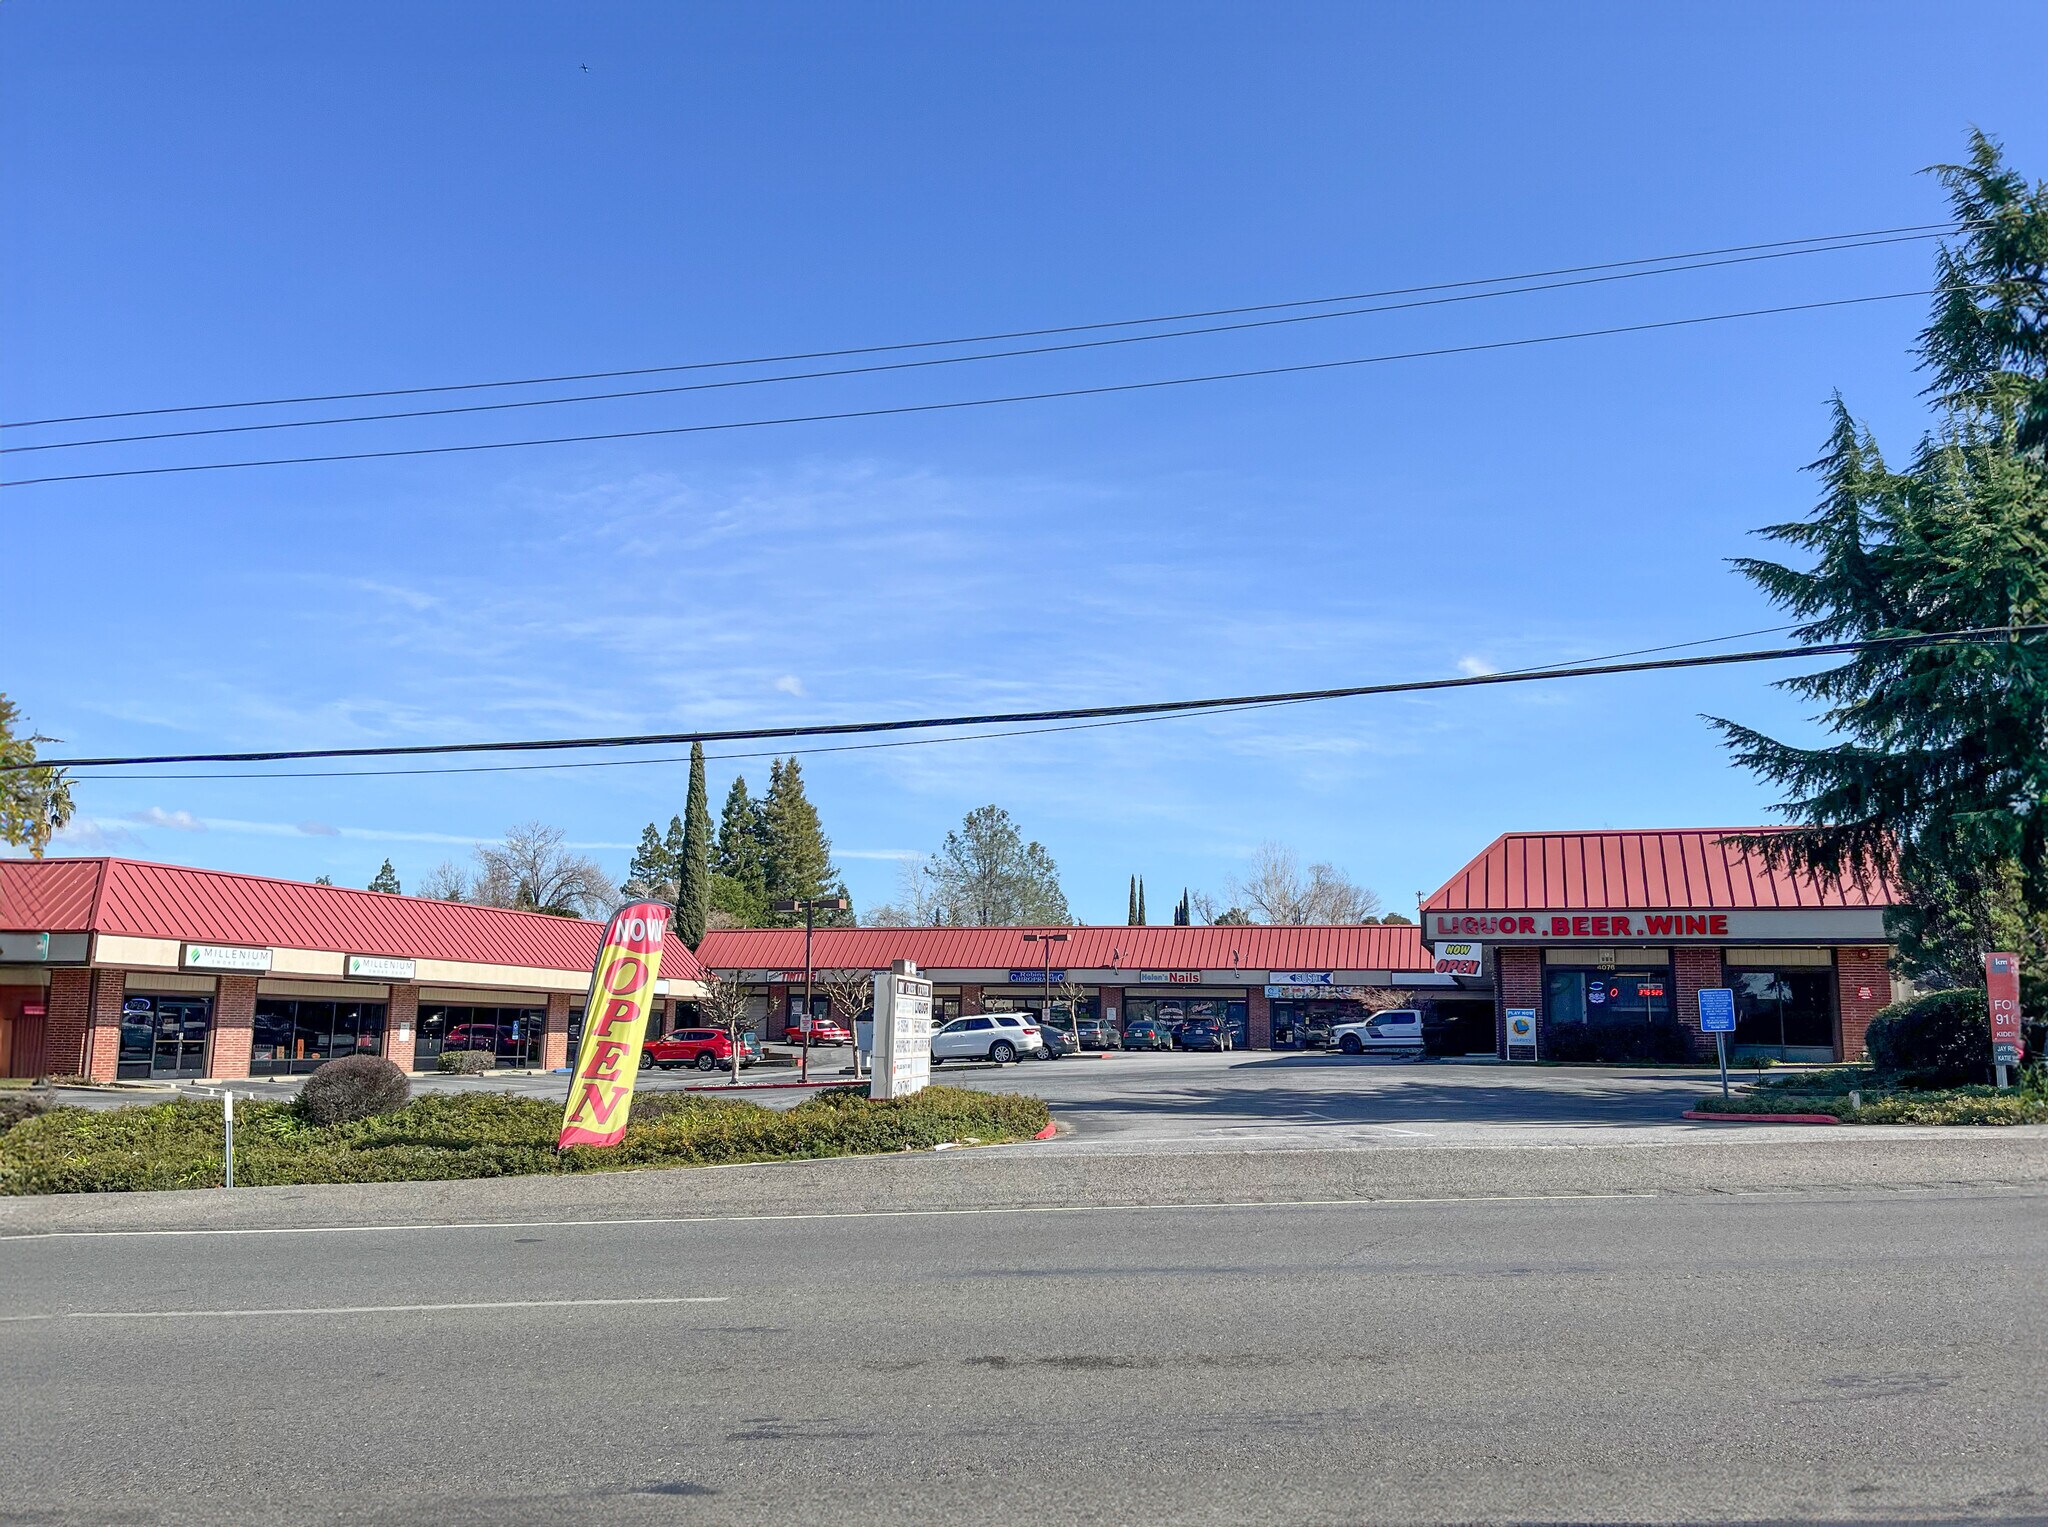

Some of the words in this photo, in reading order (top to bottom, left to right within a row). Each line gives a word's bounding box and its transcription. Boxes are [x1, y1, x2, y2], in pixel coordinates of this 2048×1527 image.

[615, 917, 664, 943] NOW
[1437, 916, 1536, 935] LIQUOR
[204, 948, 269, 960] MILLENIUM
[1445, 944, 1472, 955] NOW
[362, 959, 413, 970] MILLENIUM
[1435, 959, 1480, 975] OPEN
[781, 971, 817, 982] TINTIG
[1141, 973, 1169, 982] Helen's
[1169, 972, 1200, 983] Nails
[1295, 972, 1321, 985] SUSHI
[128, 1000, 148, 1010] OPEN
[567, 957, 650, 1125] OPEN
